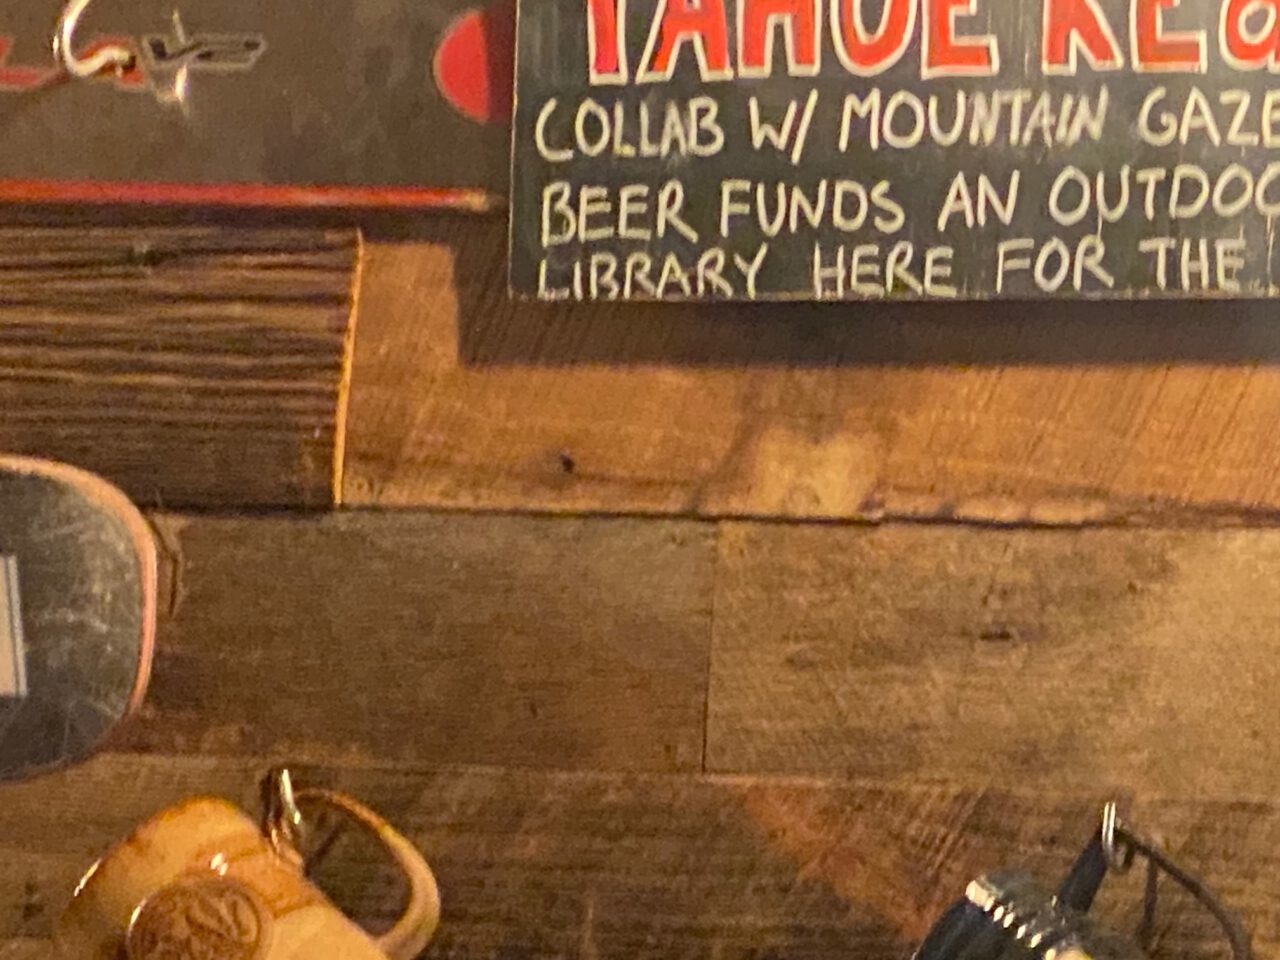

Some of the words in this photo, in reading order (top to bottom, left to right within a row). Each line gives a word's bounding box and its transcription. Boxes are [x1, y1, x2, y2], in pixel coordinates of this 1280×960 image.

[534, 96, 725, 163] COLLAB
[749, 88, 819, 164] W/
[838, 87, 1109, 152] MOUNTAIN
[541, 179, 698, 247] BEER
[720, 178, 906, 238] FUNDS
[938, 170, 1020, 232] AN
[536, 242, 768, 302] LIBRARY
[813, 244, 957, 298] HERE
[996, 235, 1114, 294] FOR
[1138, 236, 1245, 292] THE
